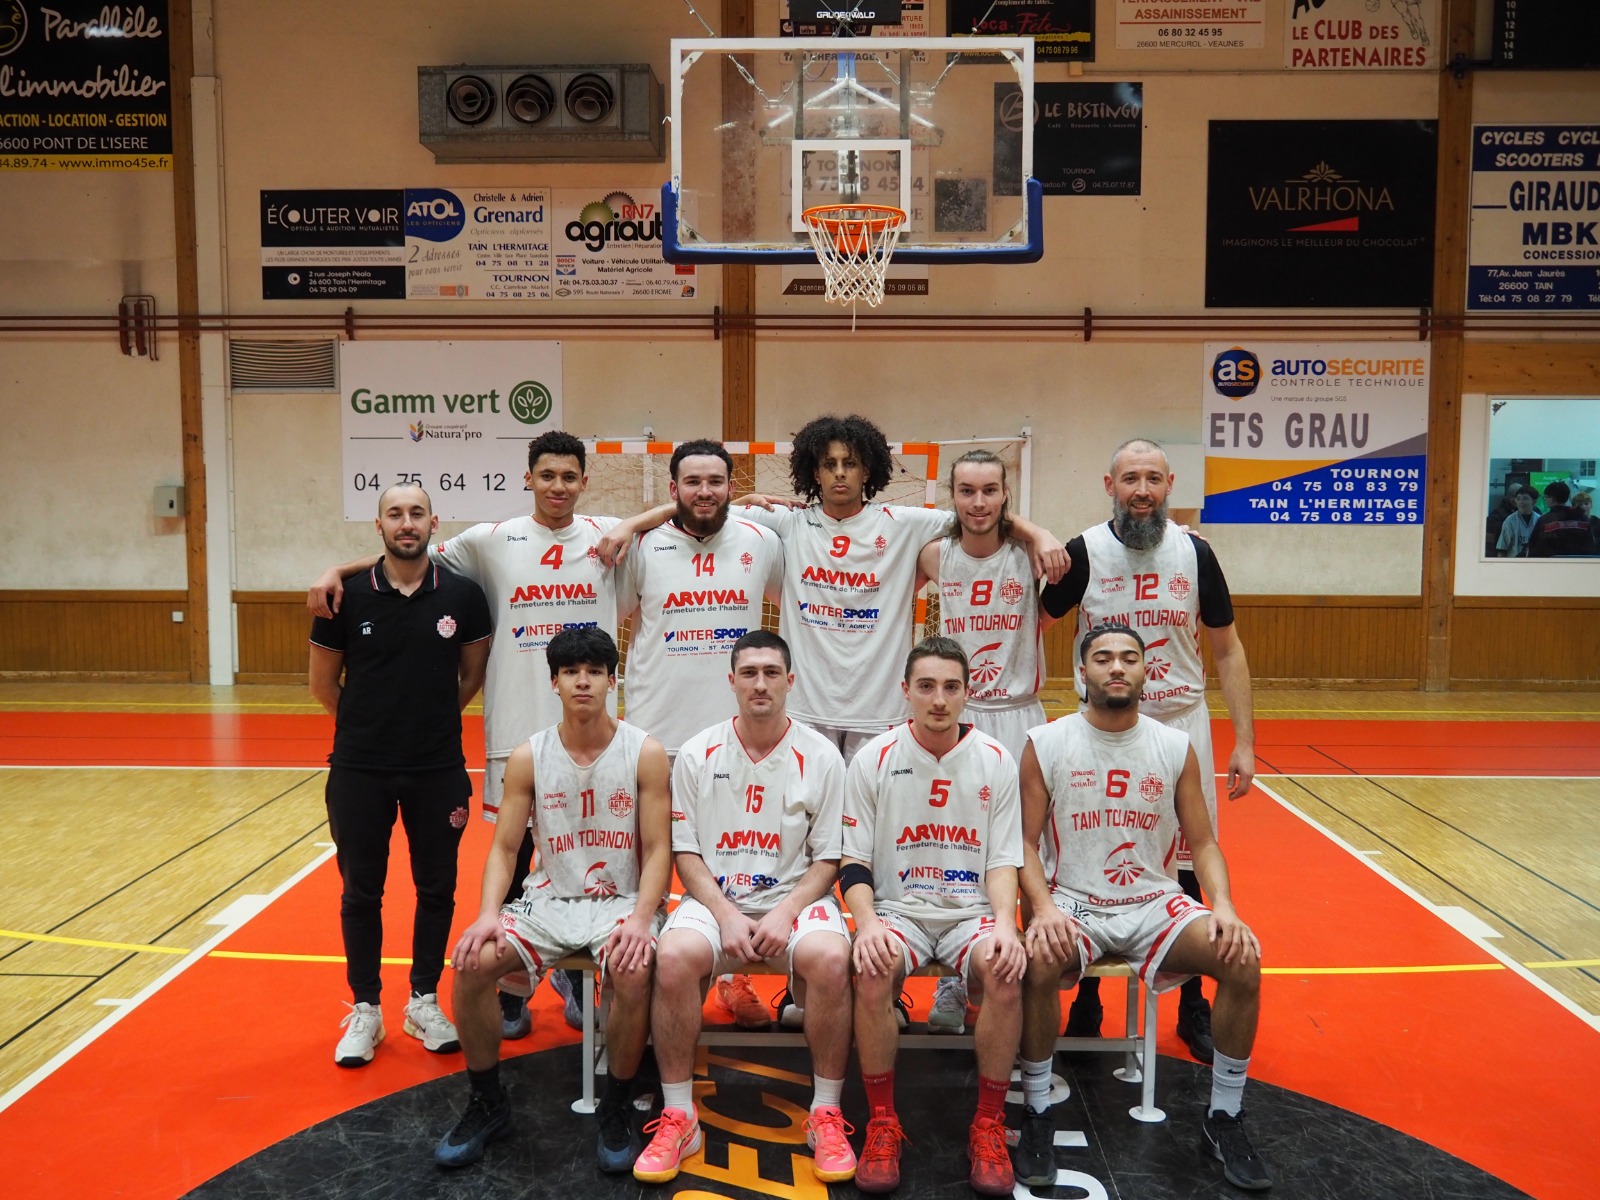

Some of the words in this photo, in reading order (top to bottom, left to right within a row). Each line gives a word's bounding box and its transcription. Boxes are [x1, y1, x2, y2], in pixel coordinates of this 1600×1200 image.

[1506, 1, 1516, 9] 10
[1134, 8, 1248, 20] ASSAINISSEMENT
[1506, 11, 1516, 19] 11
[40, 5, 162, 42] Parallèle
[1292, 26, 1309, 40] LE
[1314, 19, 1362, 40] CLUB
[1369, 25, 1399, 40] DES
[1505, 21, 1515, 29] 12
[1158, 29, 1169, 37] 06
[1171, 29, 1182, 37] 80
[1185, 29, 1196, 37] 32
[1198, 29, 1209, 37] 45
[1211, 29, 1223, 37] 95
[1504, 31, 1515, 39] 13
[1504, 41, 1514, 49] 14
[1292, 46, 1426, 68] PARTENAIRES
[1503, 51, 1513, 59] 15
[0, 64, 166, 99] l'immobilier
[1044, 102, 1062, 118] LE
[49, 113, 107, 127] LOCATION
[115, 113, 167, 127] GESTION
[33, 137, 73, 149] PONT
[78, 137, 96, 149] DE
[100, 137, 148, 149] L'ISERE
[1481, 131, 1545, 146] CYCLES
[59, 157, 169, 168] www.immo45e.fr
[1495, 152, 1584, 167] SCOOTERS
[473, 193, 506, 202] Christelle
[510, 194, 516, 202] &
[521, 193, 544, 202] Adrien
[1249, 186, 1395, 211] VALRHONA
[1509, 180, 1600, 212] GIRAUD
[354, 207, 399, 224] VOIR
[407, 198, 460, 220] ATOL
[474, 205, 544, 224] Grenard
[622, 204, 654, 220] RN7
[1522, 222, 1599, 246] MBK
[468, 243, 488, 251] TAIN
[493, 243, 549, 251] L'HERMITAGE
[1222, 238, 1279, 247] IMAGINONS
[1282, 238, 1292, 247] LE
[1296, 238, 1344, 247] MEILLEUR
[1346, 238, 1360, 247] DU
[1363, 238, 1418, 247] CHOCOLAT
[408, 244, 420, 264] 2
[492, 274, 550, 282] TOURNON
[1512, 269, 1532, 278] Jean
[1537, 268, 1566, 278] Jaurès
[1498, 282, 1528, 290] 26600
[1534, 282, 1554, 290] TAIN
[1511, 294, 1522, 303] 75
[1527, 294, 1540, 303] 08
[1545, 294, 1556, 303] 27
[1561, 294, 1572, 303] 79
[1218, 360, 1255, 382] as
[1271, 378, 1341, 387] CONTROLE
[1348, 378, 1424, 387] TECHNIQUE
[350, 388, 435, 414] Gamm
[442, 389, 500, 414] vert
[425, 429, 482, 442] Natura'pro
[1210, 412, 1264, 448] ETS
[1284, 412, 1370, 448] GRAU
[1330, 468, 1419, 478] TOURNON
[354, 473, 380, 491] 04
[439, 473, 466, 491] 64
[482, 473, 506, 491] 12
[1272, 482, 1292, 492] 04
[1303, 482, 1322, 492] 75
[1333, 482, 1354, 492] 08
[1366, 482, 1387, 492] 83
[1398, 482, 1418, 492] 79
[1249, 498, 1288, 508] TAIN
[1299, 498, 1418, 508] L'HERMITAGE
[1270, 512, 1290, 522] 04
[1300, 512, 1320, 522] 75
[1331, 512, 1352, 522] 08
[1364, 512, 1384, 522] 25
[1396, 512, 1418, 522] 99
[830, 535, 850, 558] 9
[540, 544, 564, 570] 4
[691, 552, 715, 577] 14
[802, 566, 880, 588] ARVIVAL
[510, 583, 598, 603] ARVIVAL
[970, 580, 993, 606] 8
[1132, 573, 1159, 600] 12
[510, 600, 554, 610] Fermetures
[662, 589, 749, 608] ARVIVAL
[662, 606, 706, 616] Fermetures
[808, 604, 880, 619] INTERSPORT
[676, 628, 748, 642] INTERSPORT
[1106, 769, 1130, 798] 6
[745, 784, 765, 814] 15
[928, 779, 952, 808] 5
[580, 788, 595, 818] 11
[1072, 810, 1100, 832] TAIN
[548, 832, 575, 855] TAIN
[578, 829, 634, 850] TOURNON
[896, 823, 982, 846] ARVIVAL
[910, 866, 980, 884] INTERSPORT
[1088, 889, 1166, 906] Groupama
[808, 906, 830, 922] 4
[1166, 894, 1191, 918] 6
